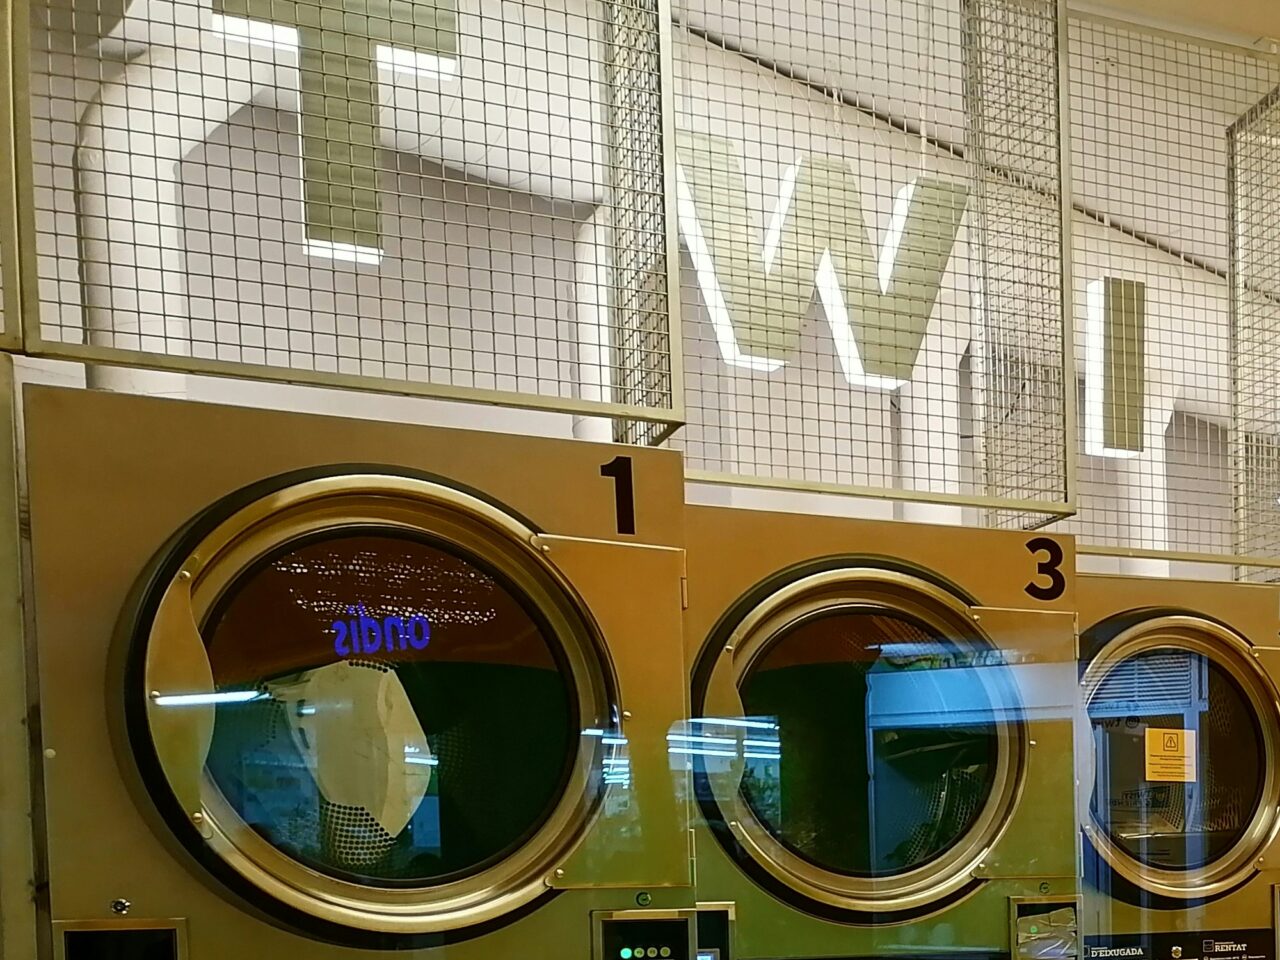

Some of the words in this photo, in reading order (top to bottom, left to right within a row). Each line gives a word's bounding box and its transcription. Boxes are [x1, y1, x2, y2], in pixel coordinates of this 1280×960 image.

[601, 456, 635, 535] 1
[1025, 538, 1065, 600] 3
[1091, 948, 1143, 957] D'EIXUGADA
[1215, 944, 1247, 952] RENTAT
